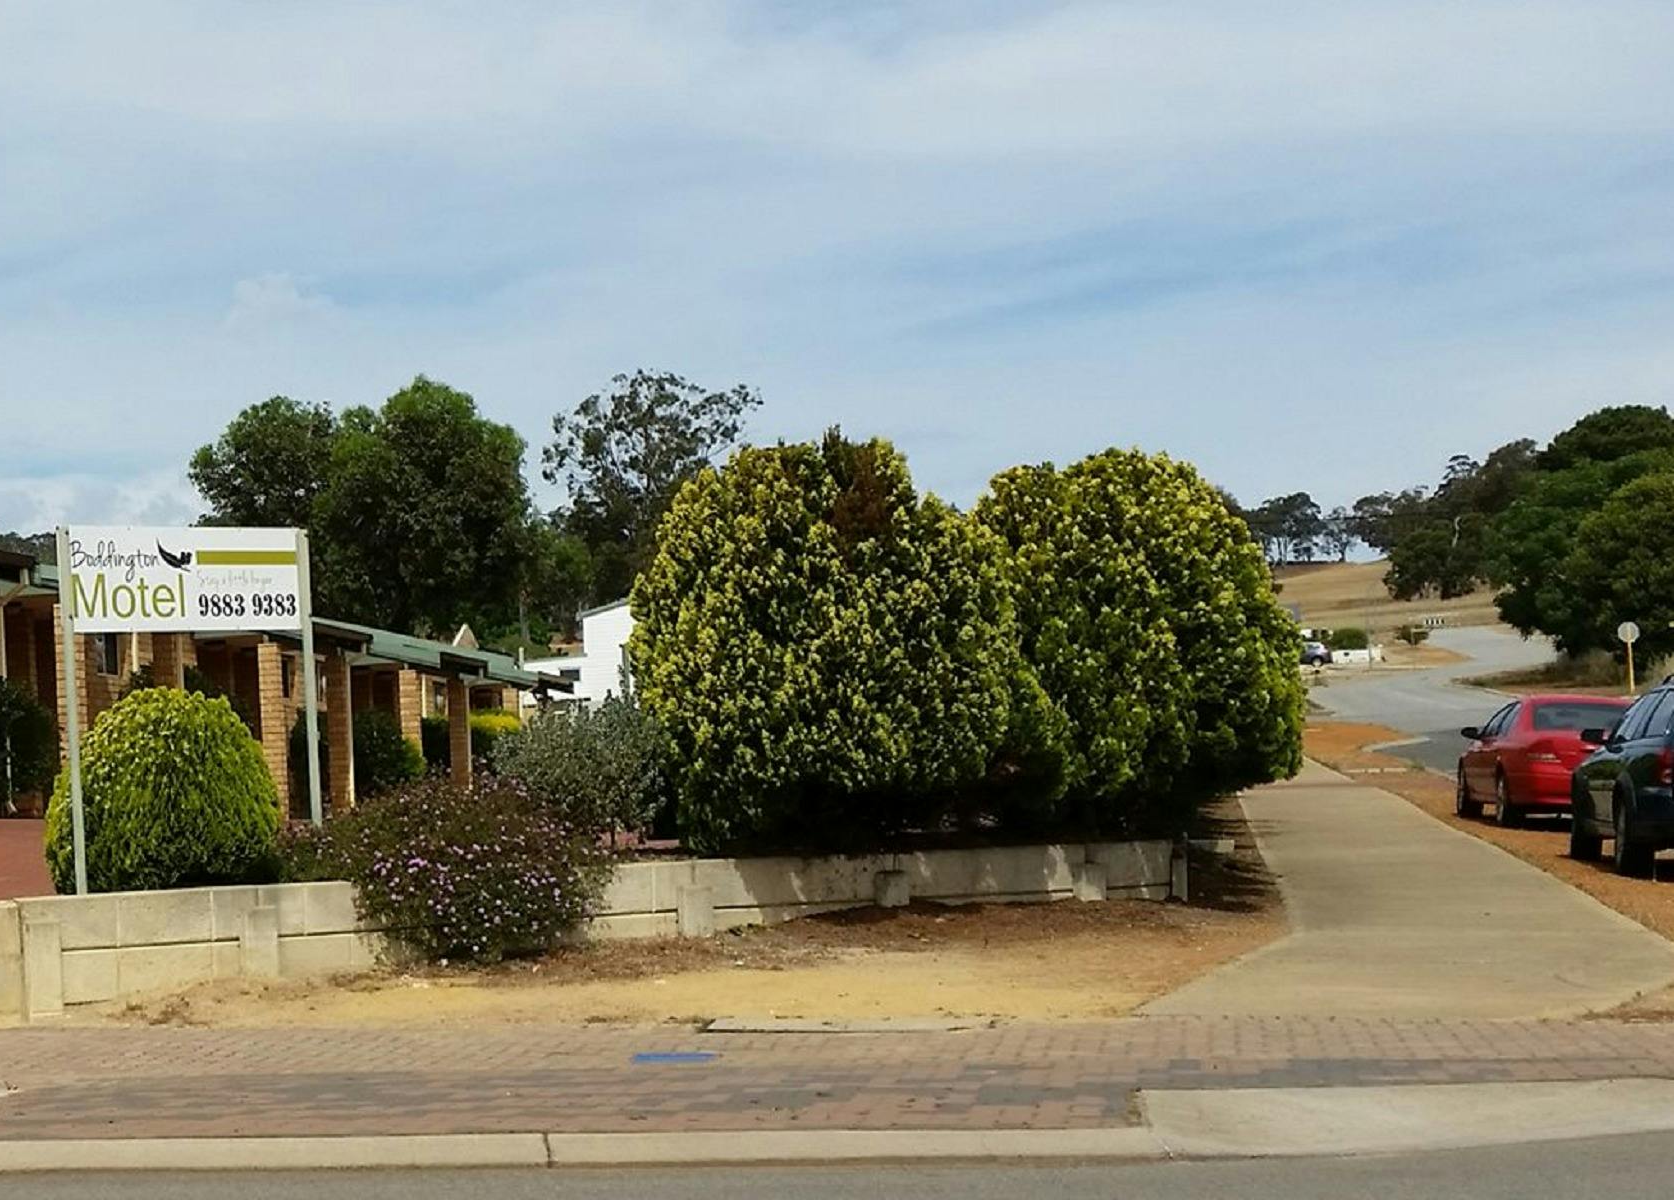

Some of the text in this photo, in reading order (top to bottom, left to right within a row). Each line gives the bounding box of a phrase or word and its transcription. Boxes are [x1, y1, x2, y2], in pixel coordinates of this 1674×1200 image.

[70, 540, 159, 582] Boddington
[70, 573, 185, 618] Motel
[198, 593, 297, 617] 9883 9383
